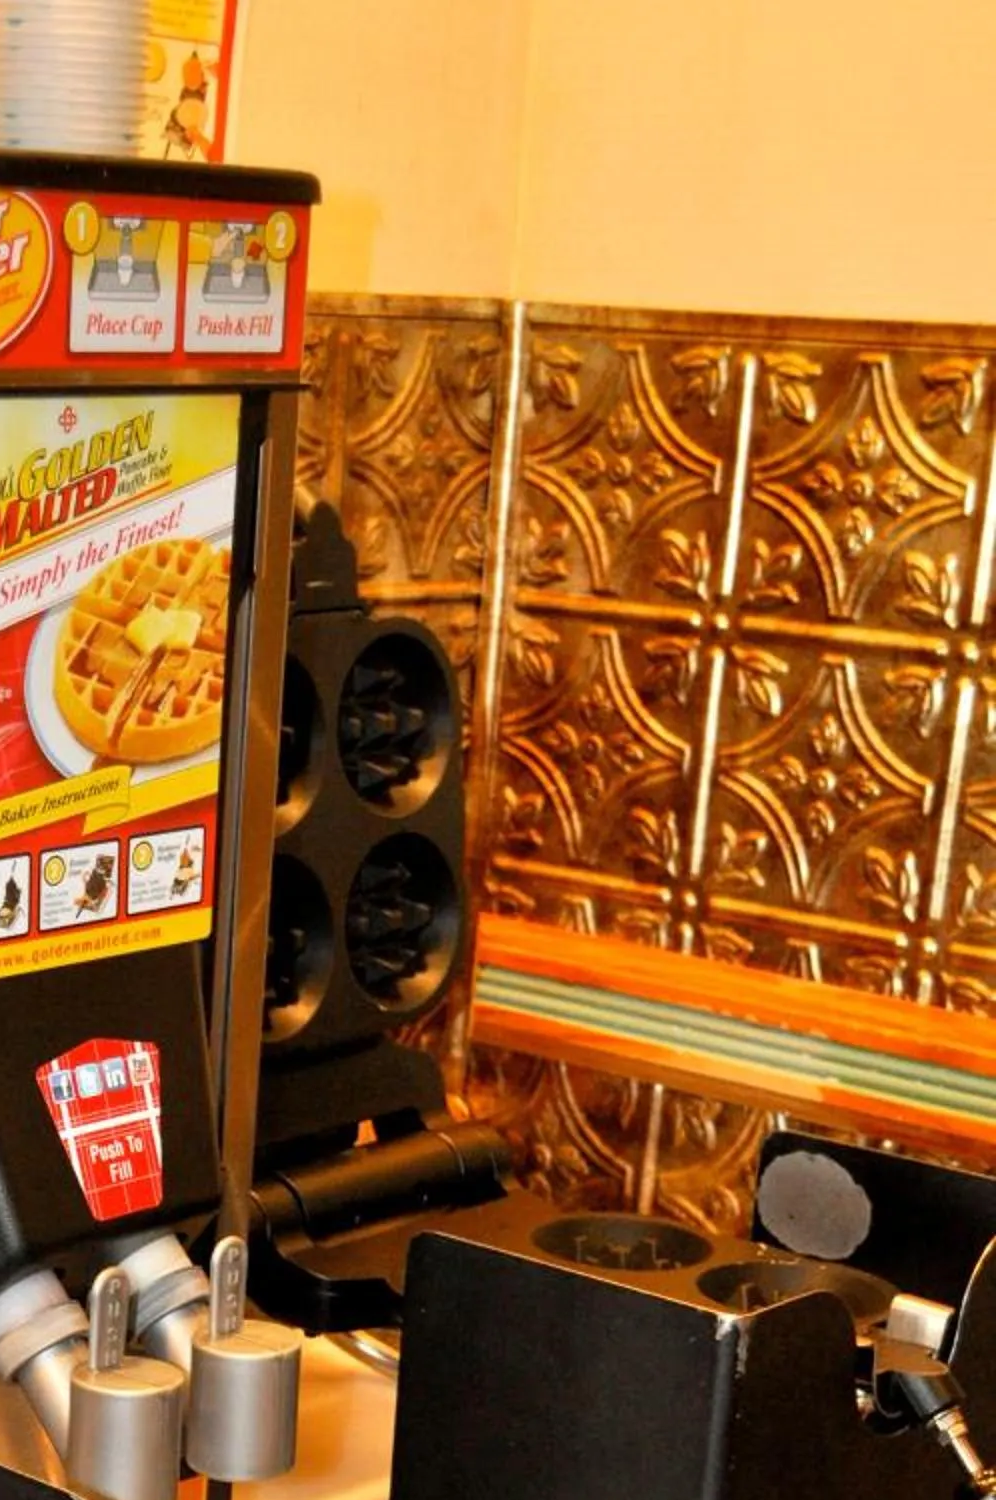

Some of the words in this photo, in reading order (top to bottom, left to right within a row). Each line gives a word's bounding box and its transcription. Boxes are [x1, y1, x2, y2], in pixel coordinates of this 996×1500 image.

[76, 213, 87, 241] 1
[274, 221, 287, 248] 2
[86, 313, 128, 336] Place
[131, 314, 164, 342] Cup
[197, 313, 233, 336] Push
[249, 314, 274, 336] Fill
[16, 410, 155, 500] GOLDEN
[76, 540, 107, 572] the
[113, 501, 185, 557] Finest!
[41, 778, 121, 814] Instructions
[105, 1063, 126, 1089] in
[89, 1139, 125, 1164] Push
[125, 1135, 144, 1153] To
[109, 1160, 134, 1184] Fill
